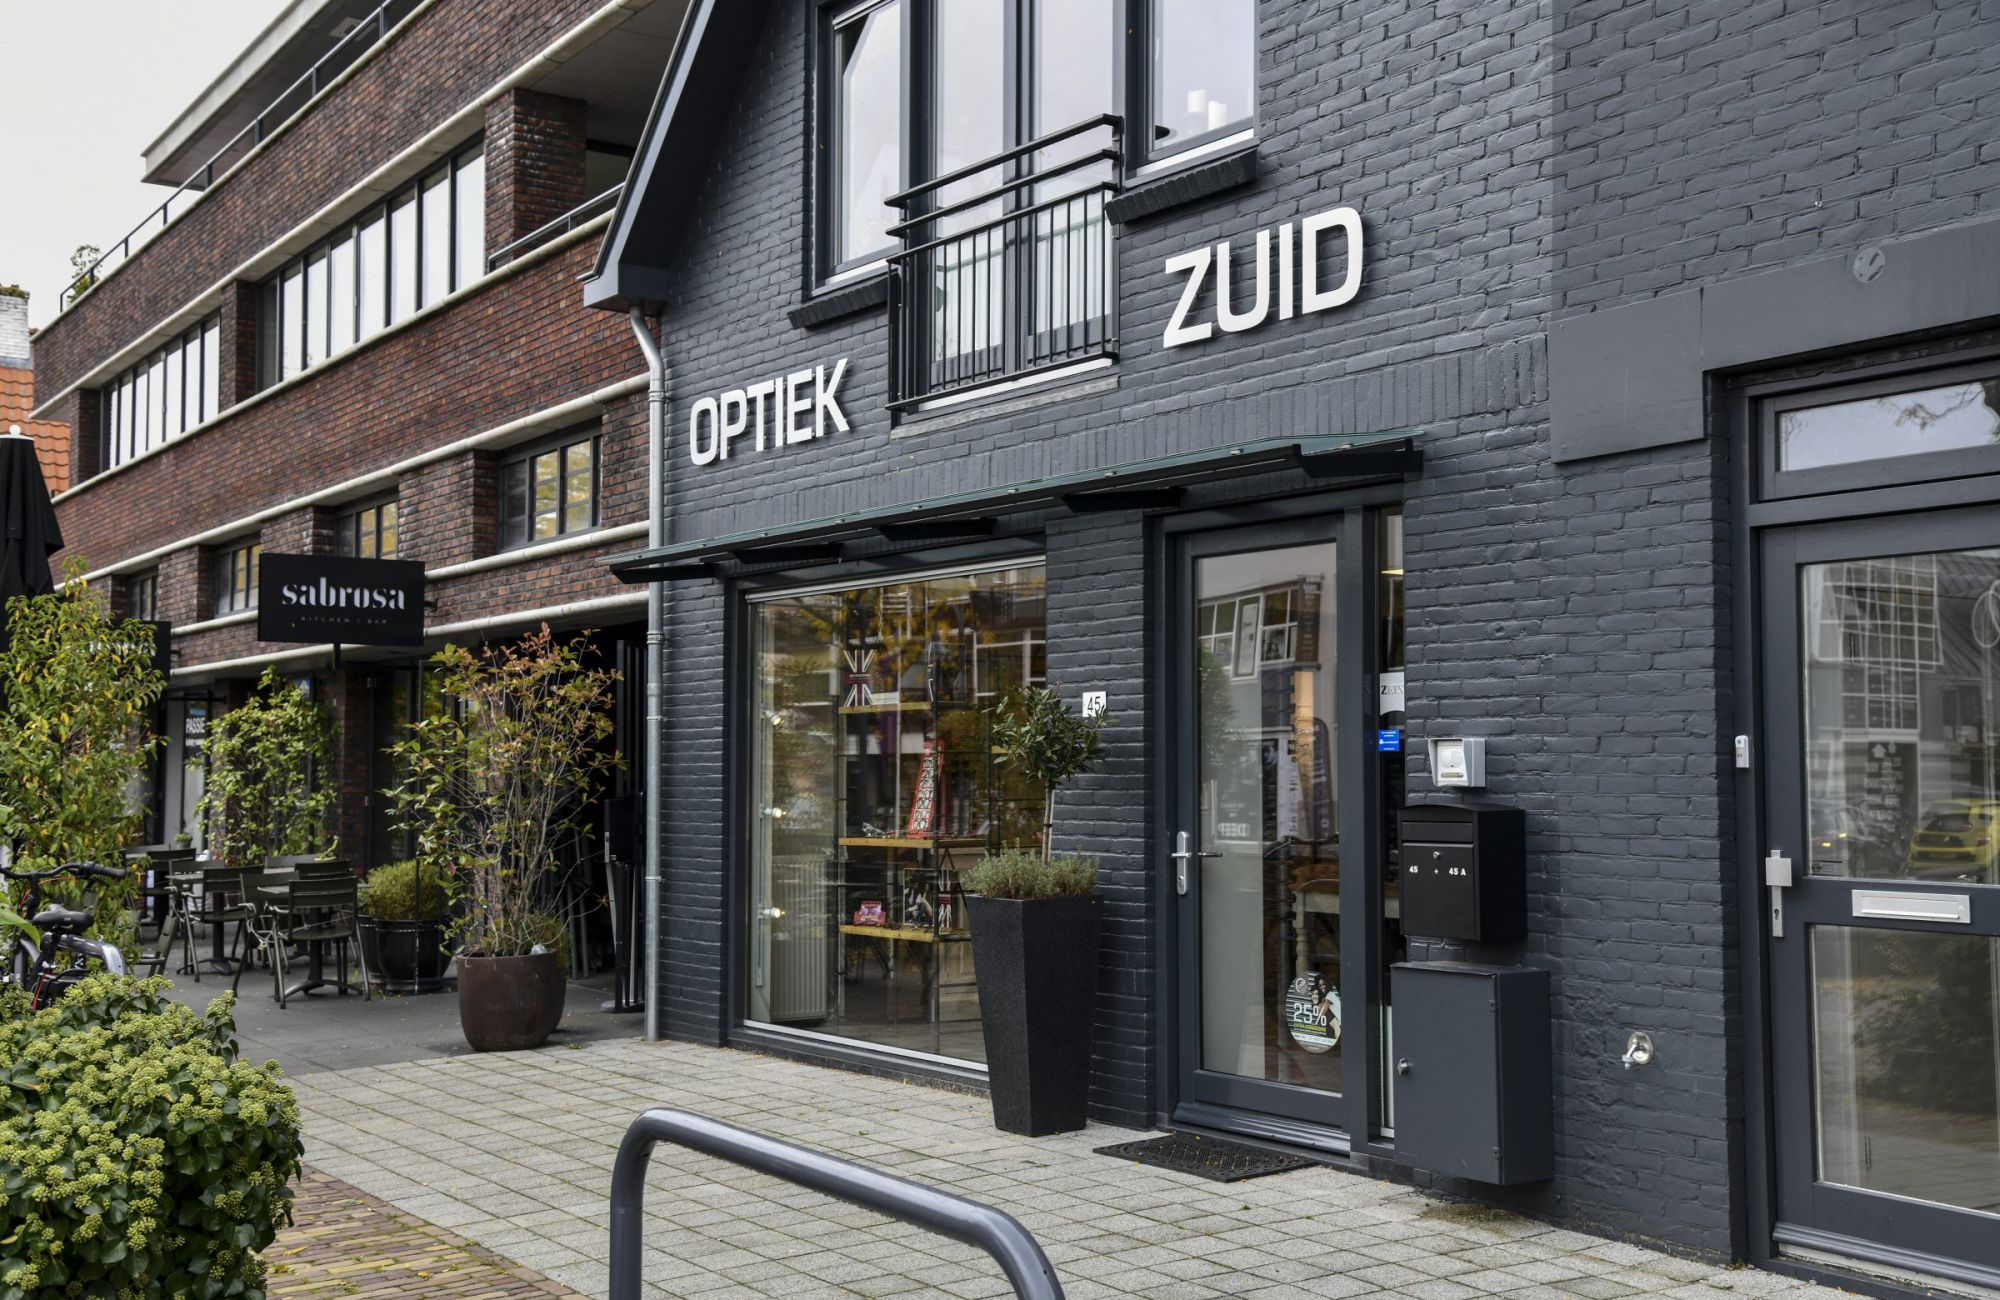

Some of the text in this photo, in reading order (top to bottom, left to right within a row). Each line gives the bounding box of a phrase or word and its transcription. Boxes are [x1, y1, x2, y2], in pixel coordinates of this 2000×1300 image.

[1163, 207, 1364, 349] ZUID
[690, 357, 850, 467] OPTIEK
[282, 576, 406, 610] sabrosa
[1088, 696, 1101, 712] 45
[1409, 865, 1418, 873] 45
[1448, 867, 1459, 876] 45
[1460, 868, 1467, 876] A
[1293, 1002, 1327, 1027] 25%
